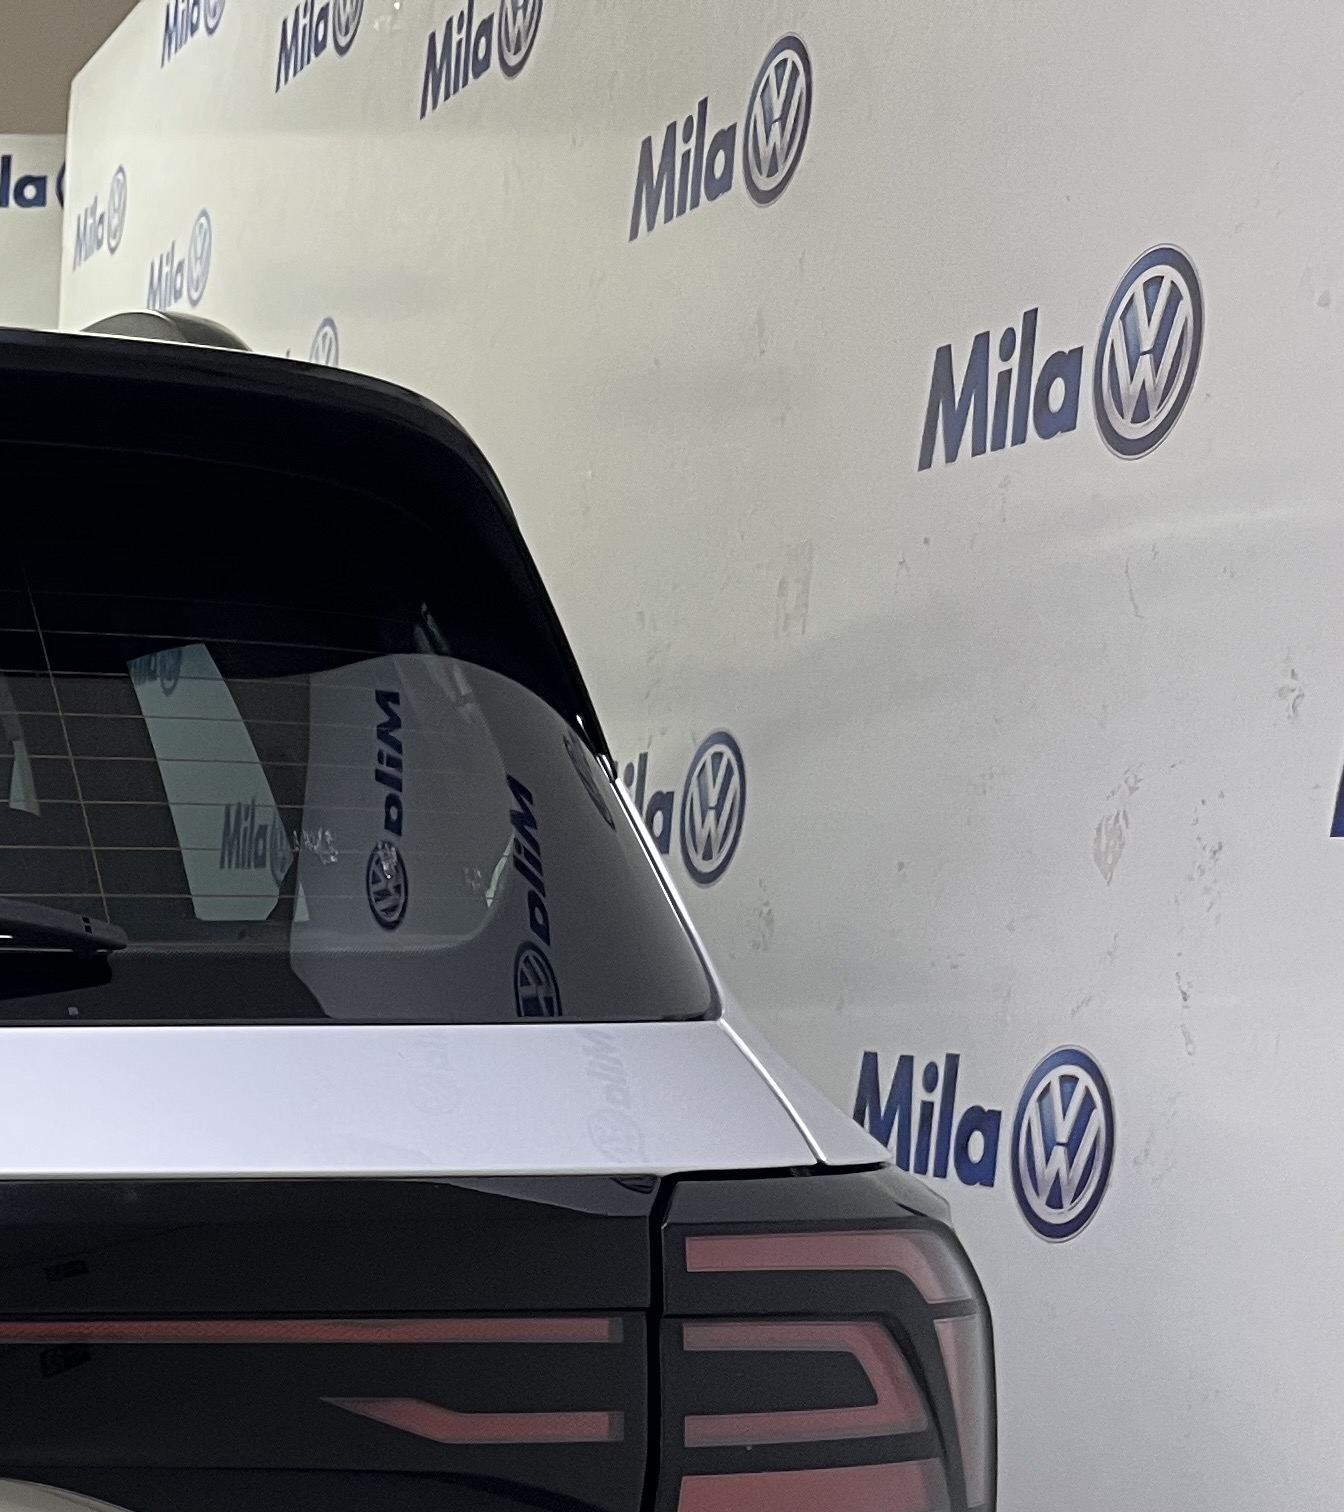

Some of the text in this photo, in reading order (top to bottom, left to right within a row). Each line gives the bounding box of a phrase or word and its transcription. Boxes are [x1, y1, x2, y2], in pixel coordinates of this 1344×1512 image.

[420, 0, 494, 120] Mila
[628, 97, 738, 243] Mila
[918, 308, 1085, 472] Mila
[853, 1050, 1002, 1187] Mila
